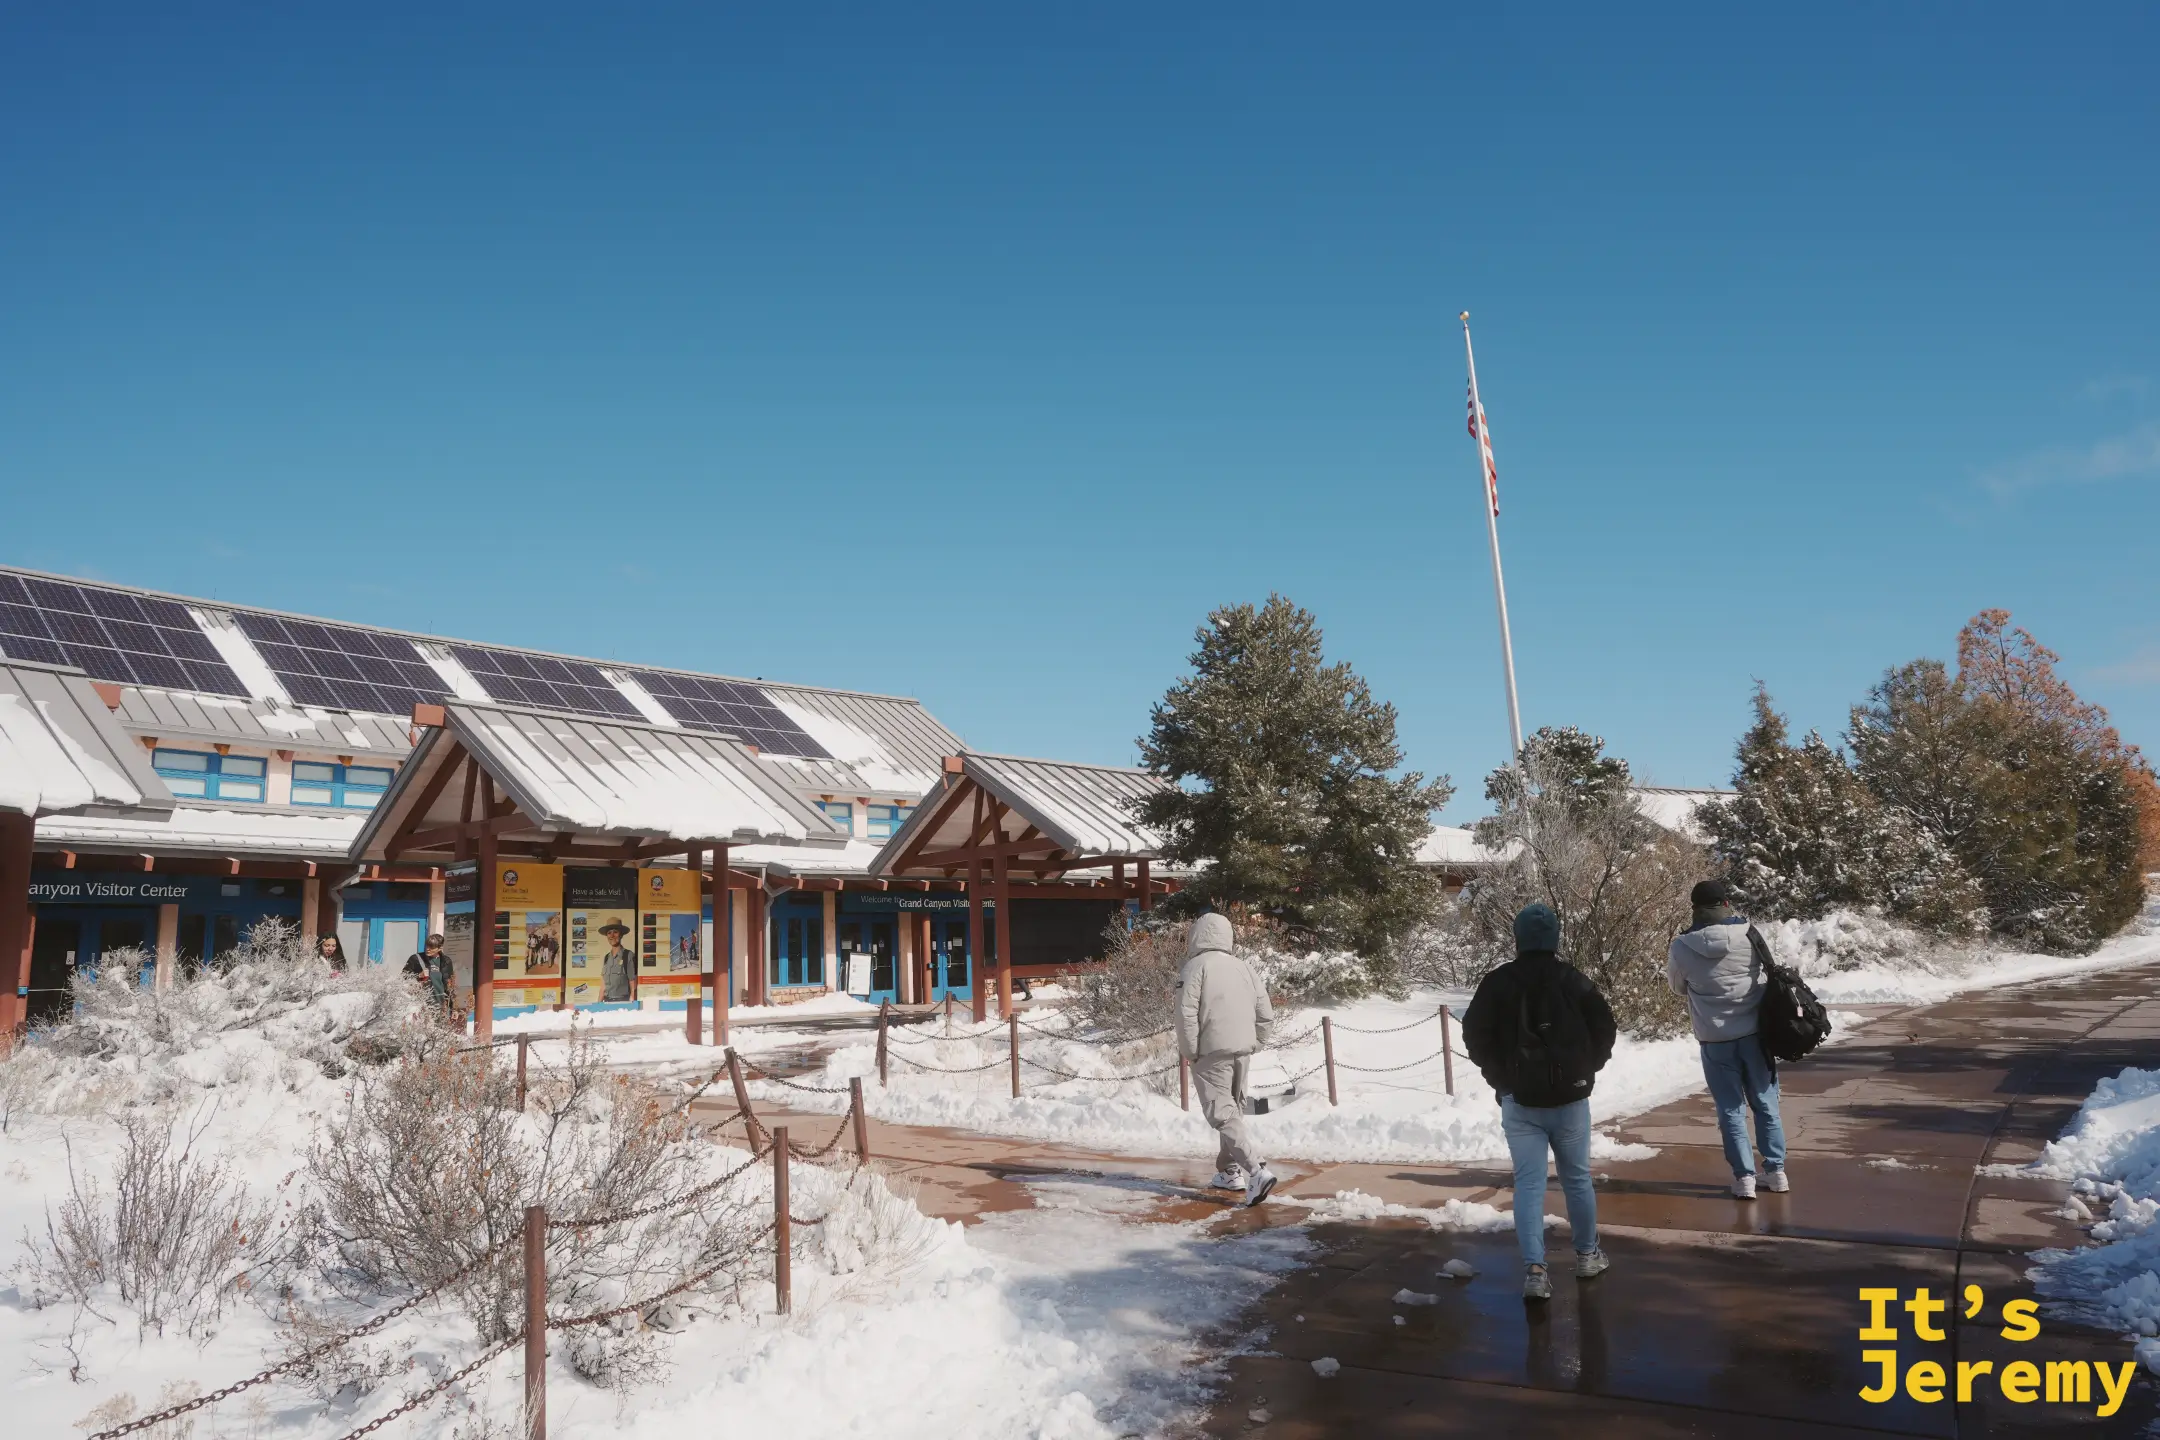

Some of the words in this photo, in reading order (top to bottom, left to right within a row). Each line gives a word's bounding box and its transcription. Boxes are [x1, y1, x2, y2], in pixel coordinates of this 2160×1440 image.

[28, 883, 81, 899] anyon
[86, 882, 136, 896] Visitor
[140, 883, 188, 897] Center
[572, 887, 587, 896] Have
[594, 888, 607, 896] Safe
[860, 895, 893, 904] Welcome
[899, 898, 922, 908] Grand
[923, 898, 951, 910] Canyon
[952, 899, 970, 908] Visit
[982, 899, 996, 908] ente
